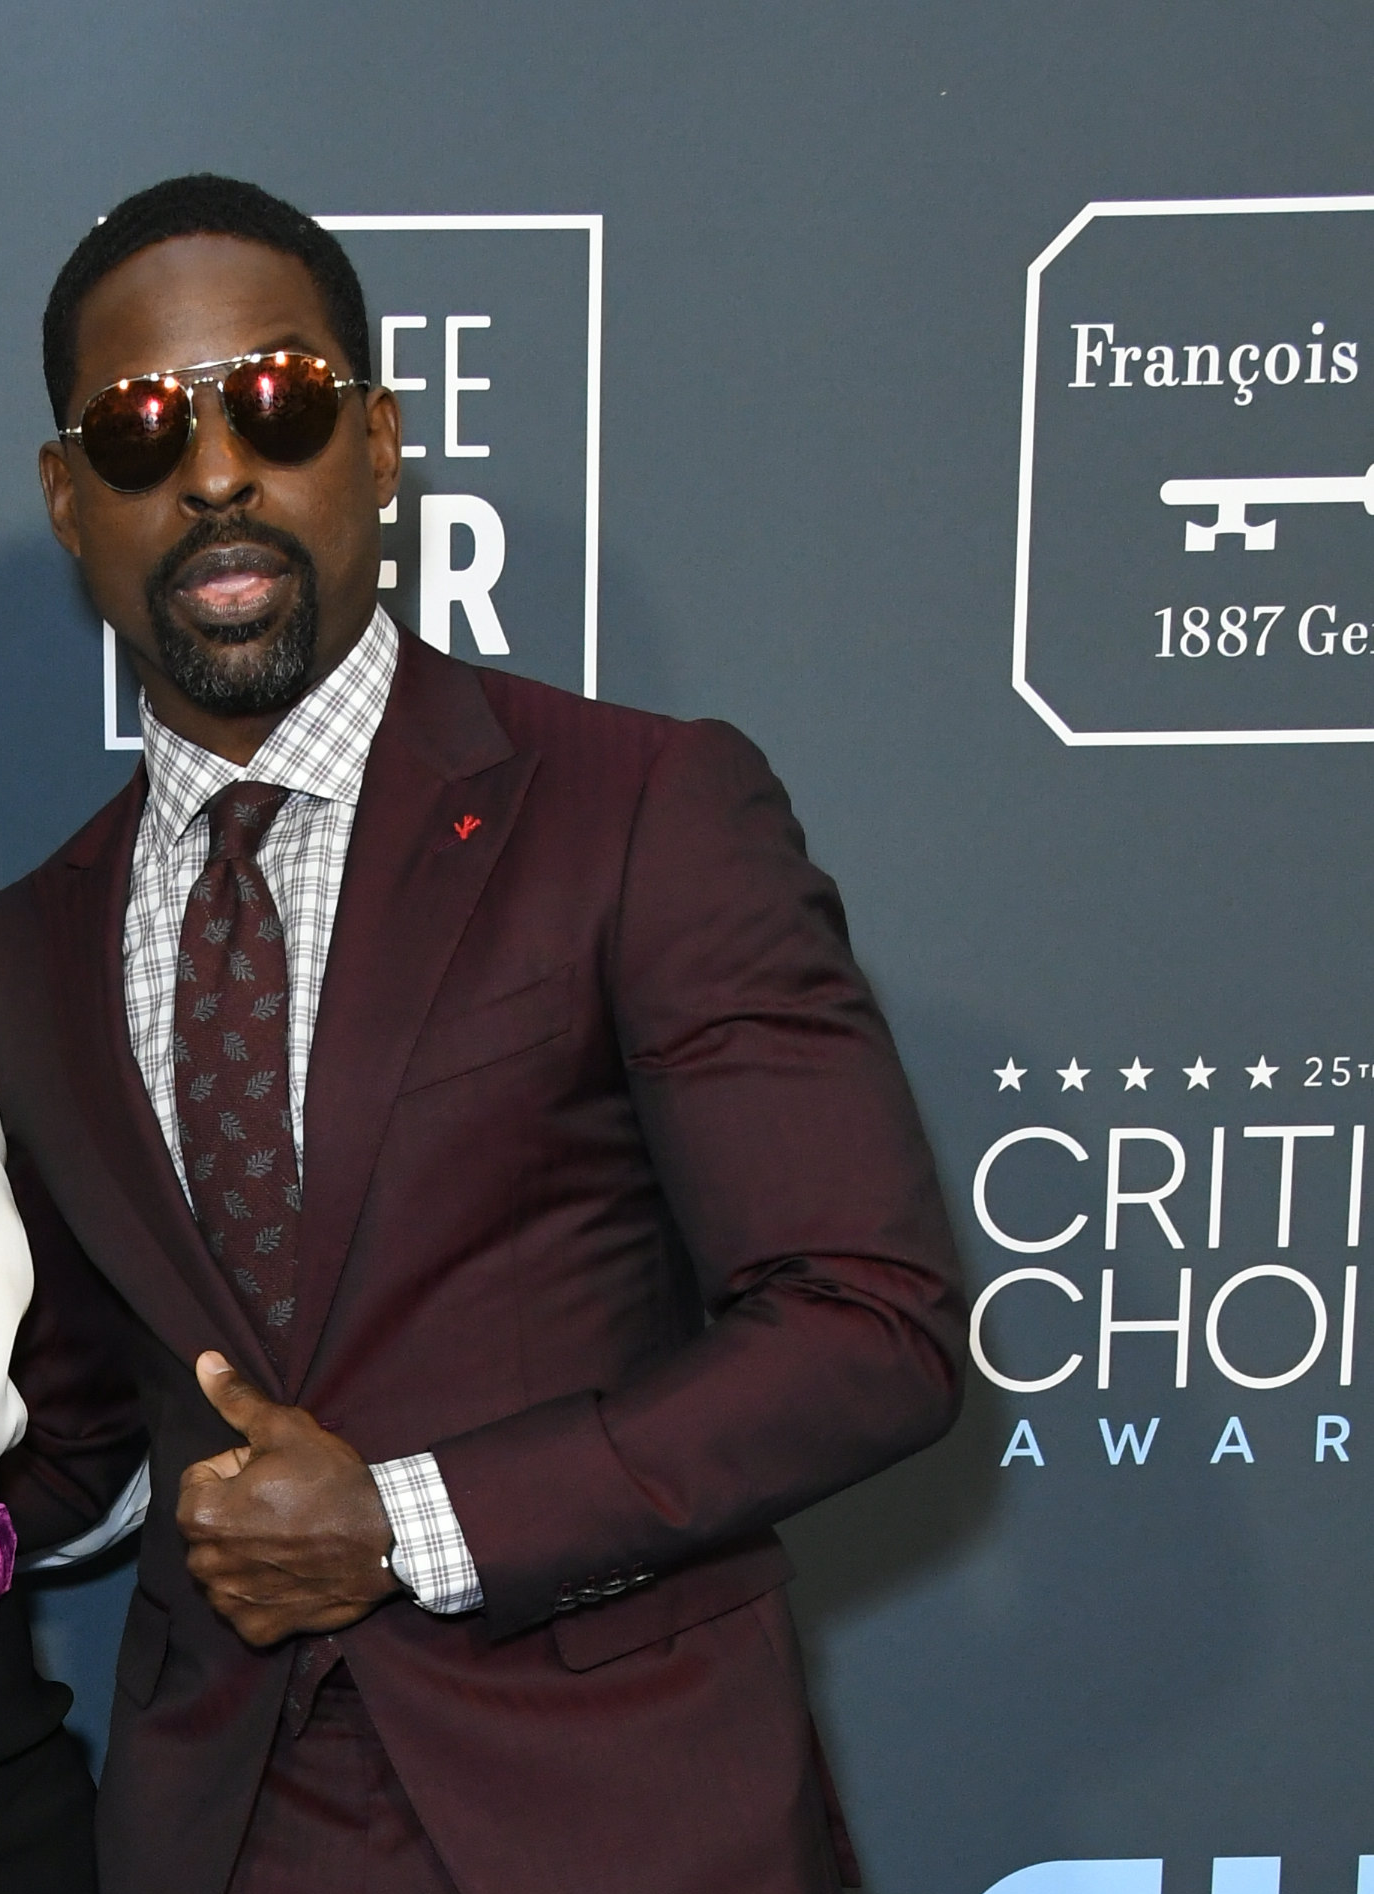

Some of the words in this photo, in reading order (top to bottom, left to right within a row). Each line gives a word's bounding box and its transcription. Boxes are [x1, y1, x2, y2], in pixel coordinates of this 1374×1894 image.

[1068, 322, 1359, 406] François
[1154, 605, 1286, 658] 1887
[1297, 604, 1374, 656] Ge
[1303, 1056, 1374, 1087] 25T
